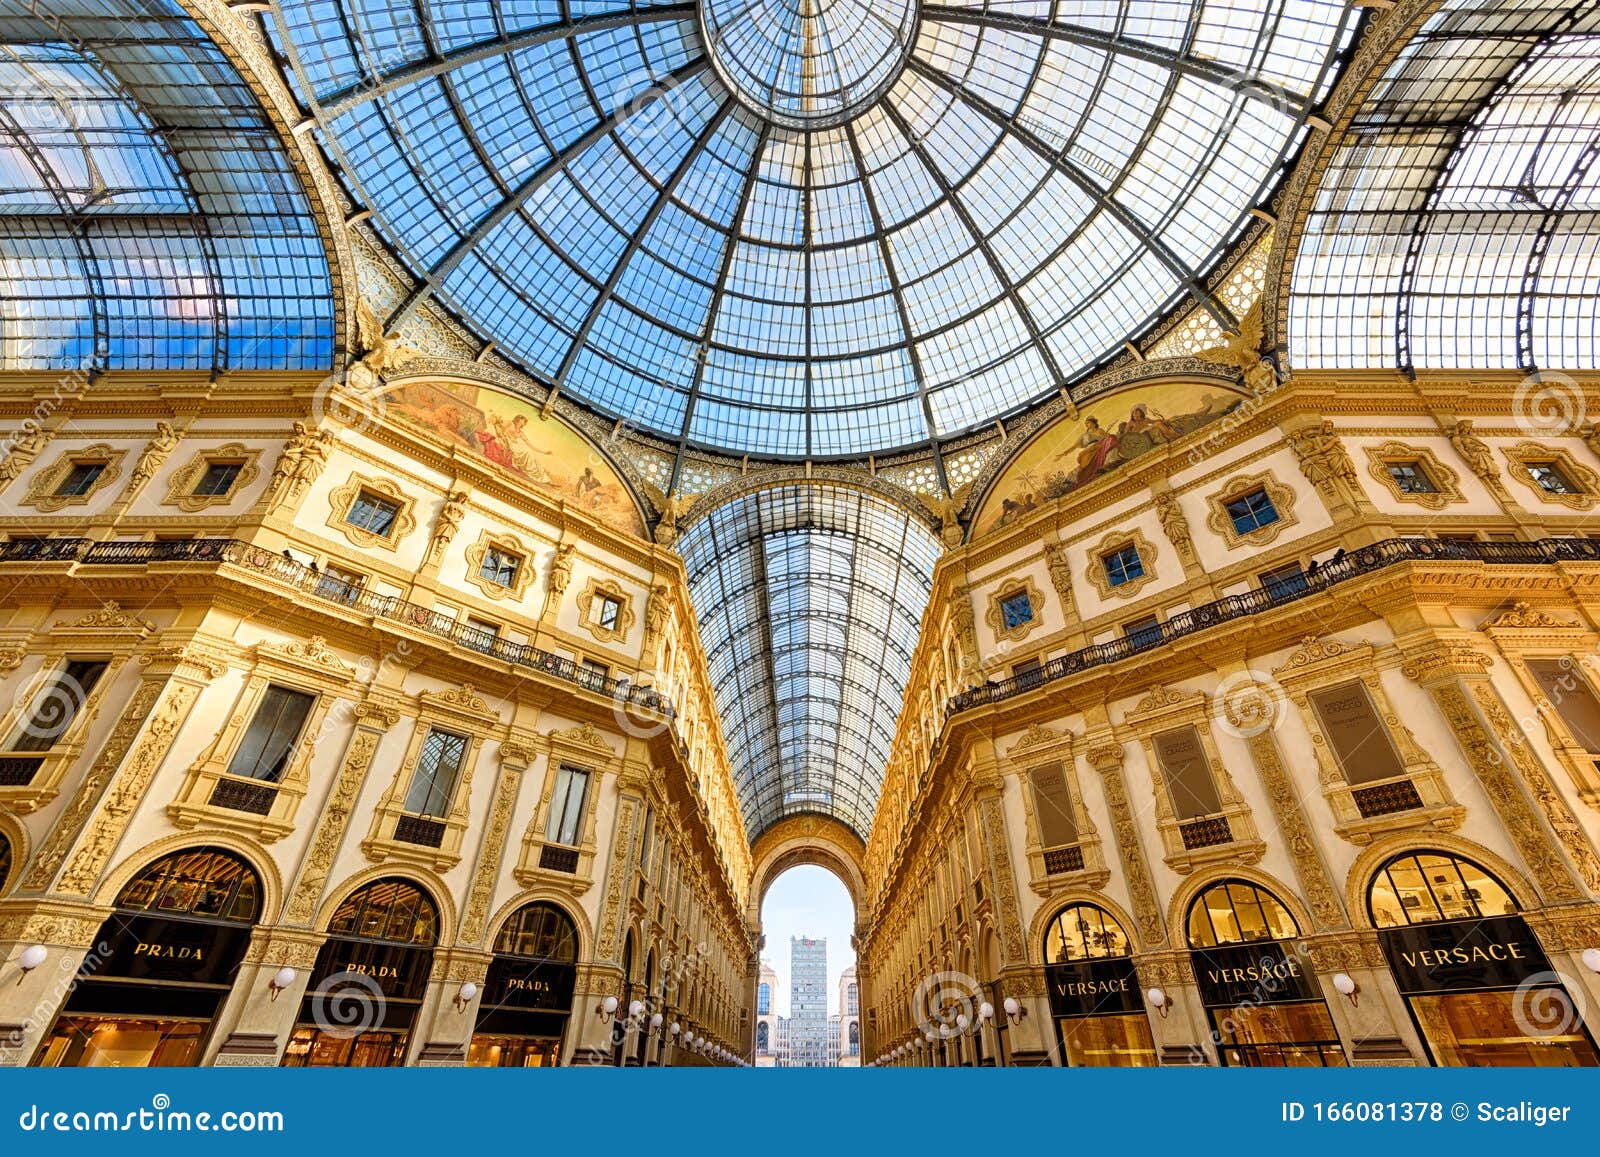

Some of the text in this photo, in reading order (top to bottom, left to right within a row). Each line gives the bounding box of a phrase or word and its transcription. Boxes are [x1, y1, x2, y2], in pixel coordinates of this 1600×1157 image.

[134, 943, 202, 961] PRADA
[1402, 942, 1527, 968] VERSACE
[346, 963, 398, 978] PRADA
[1208, 963, 1301, 984] VERSACE
[508, 979, 550, 992] PRADA
[1057, 979, 1130, 997] VERSACE
